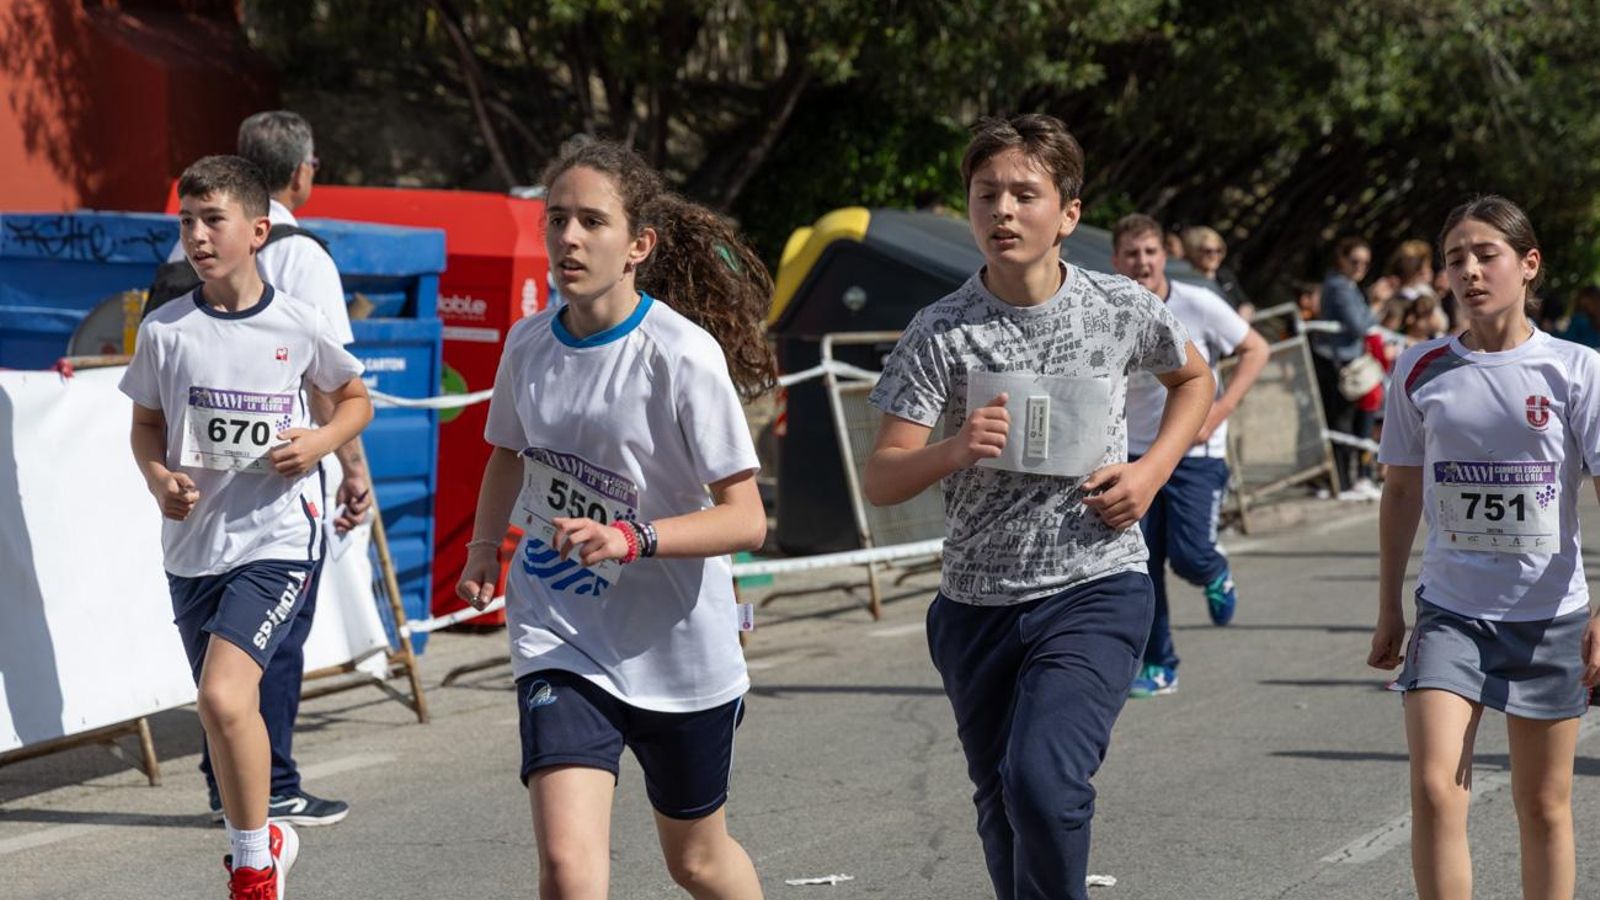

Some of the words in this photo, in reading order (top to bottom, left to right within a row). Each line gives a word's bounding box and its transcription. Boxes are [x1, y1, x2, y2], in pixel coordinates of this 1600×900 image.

[207, 417, 271, 447] 670
[1500, 473, 1511, 482] LA
[1515, 473, 1544, 482] GLORIA
[1460, 492, 1525, 521] 751
